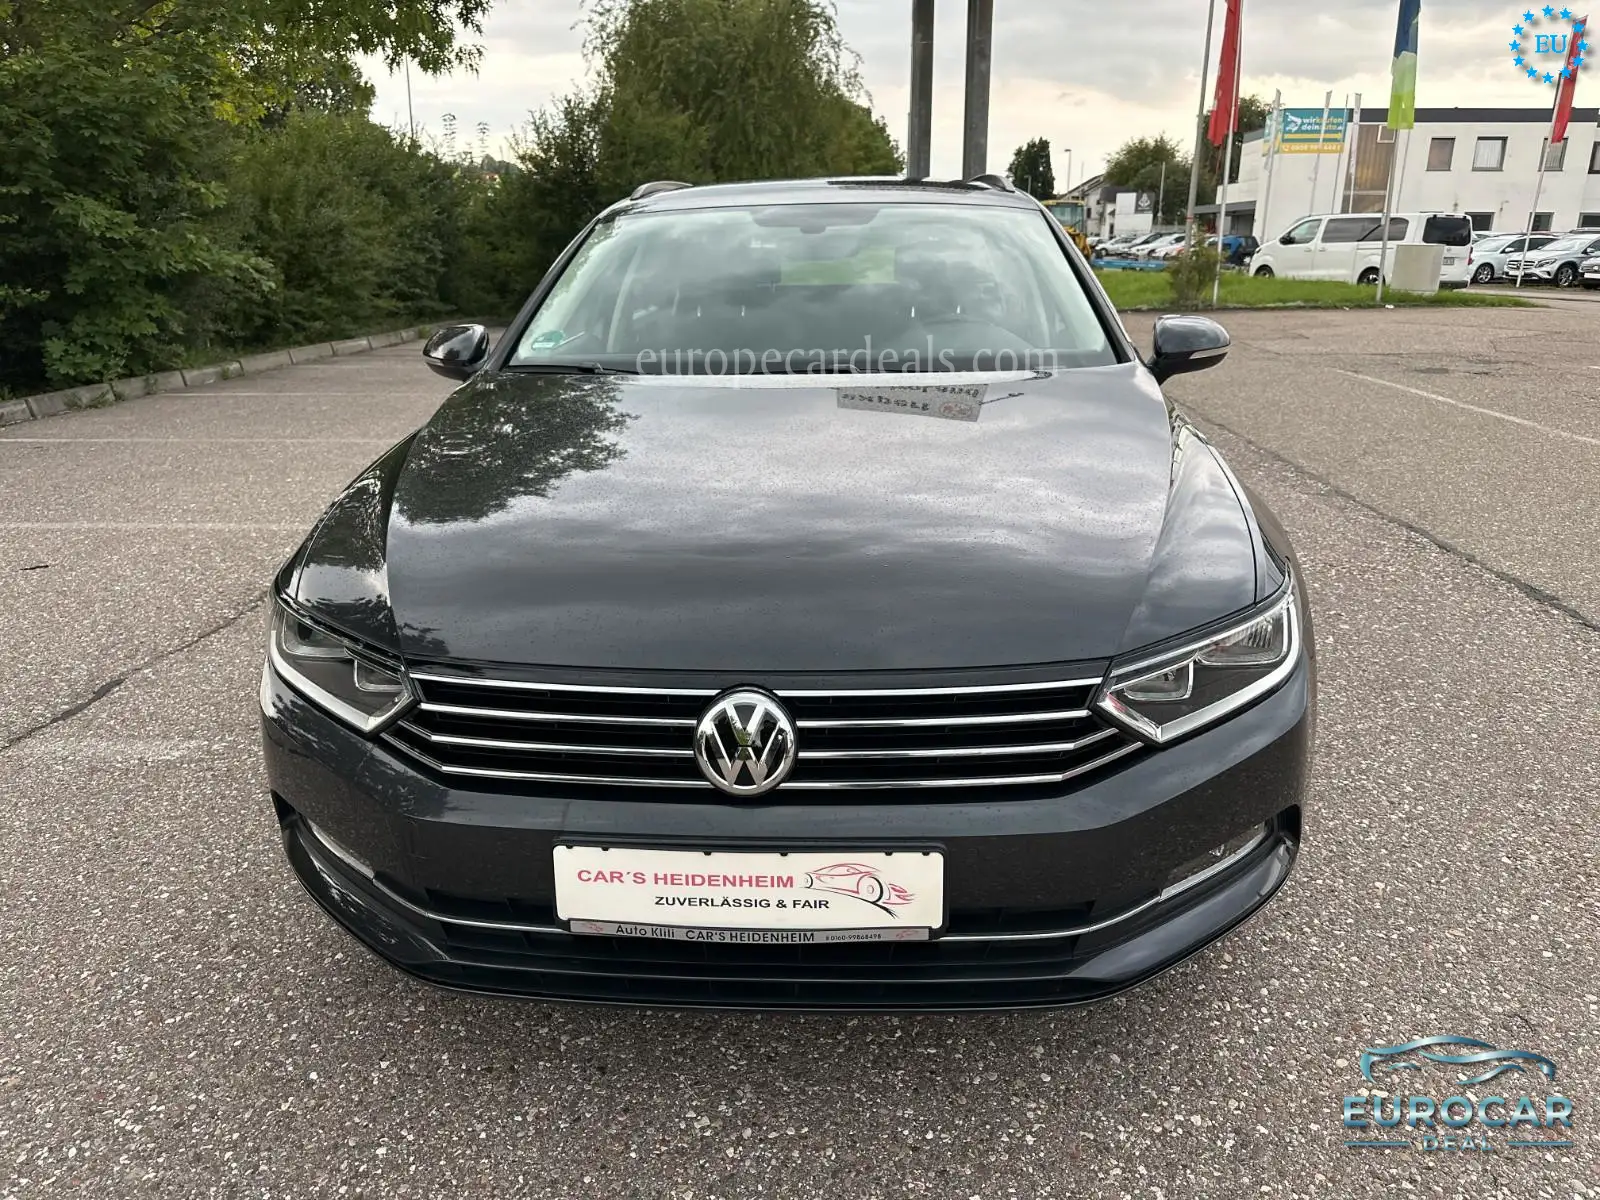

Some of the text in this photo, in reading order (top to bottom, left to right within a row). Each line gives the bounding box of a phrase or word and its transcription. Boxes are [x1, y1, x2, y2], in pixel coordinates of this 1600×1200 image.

[653, 872, 795, 889] HEIDENHEIM
[654, 896, 830, 910] ZUVERLÄSSIG & FAIR
[615, 924, 648, 938] Auto
[729, 930, 815, 944] HEIDENHEIM
